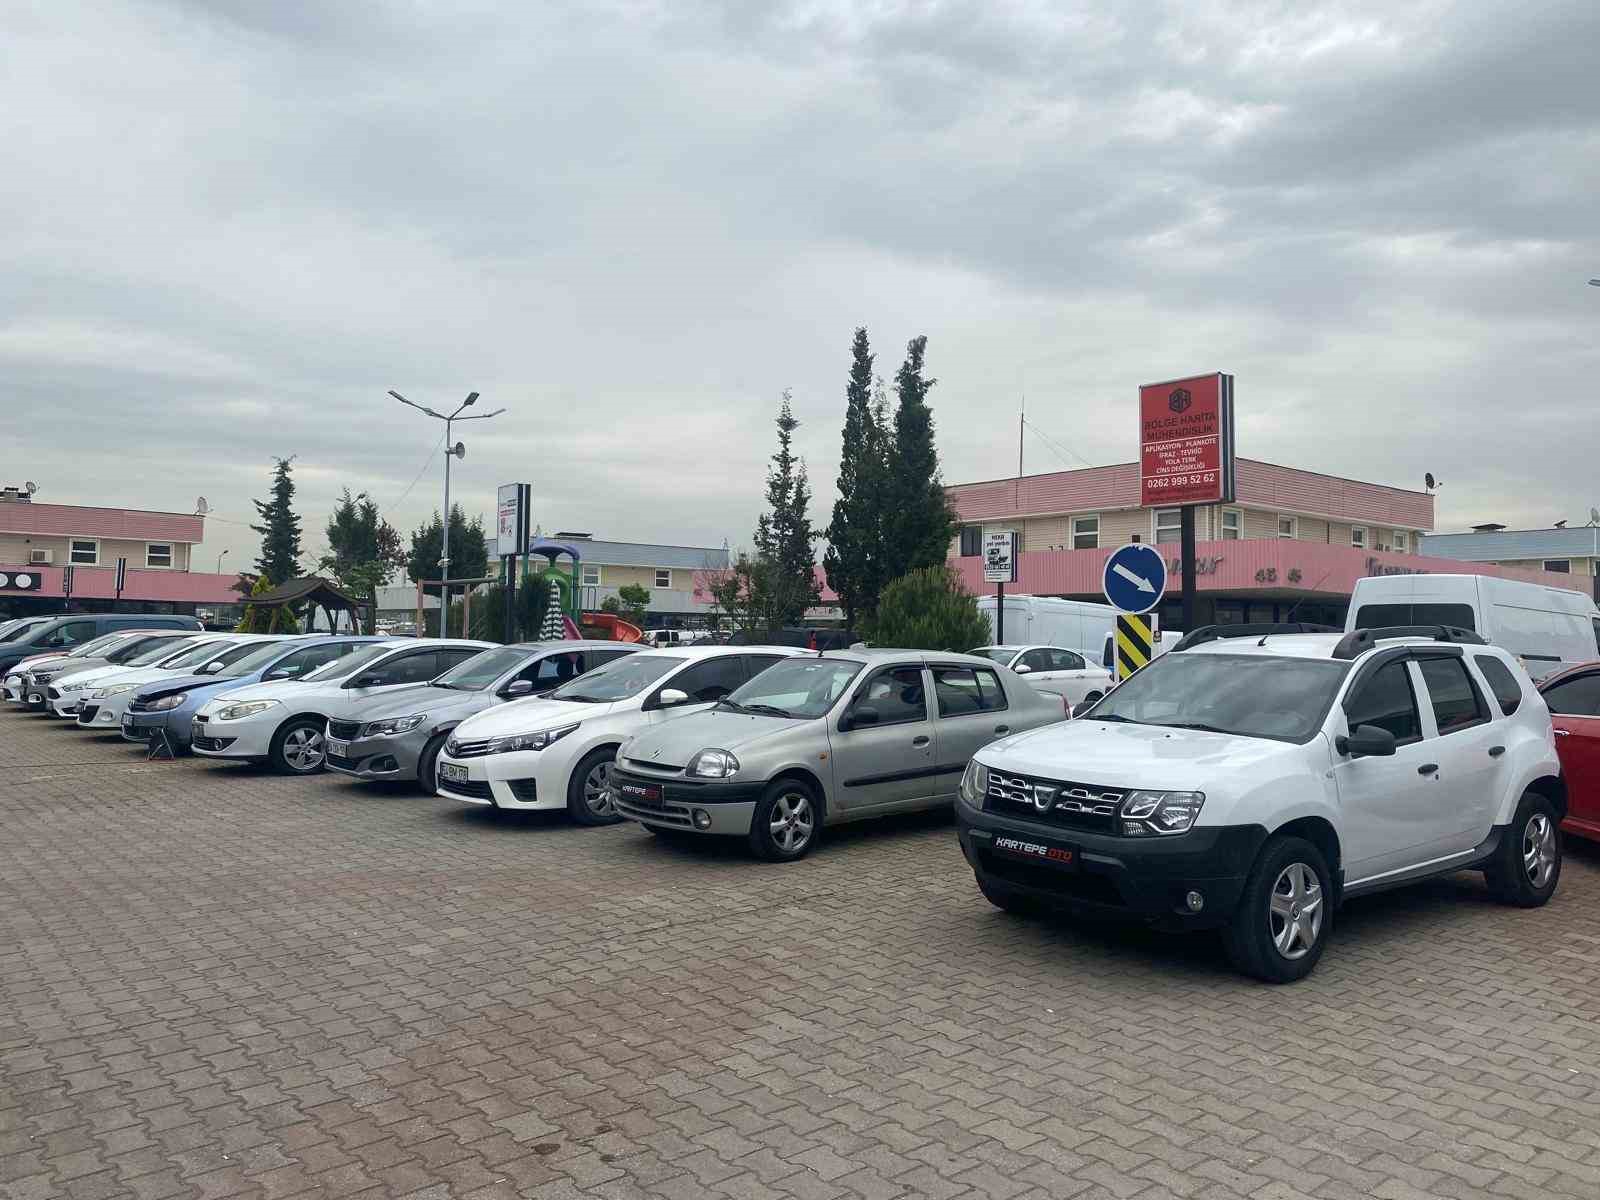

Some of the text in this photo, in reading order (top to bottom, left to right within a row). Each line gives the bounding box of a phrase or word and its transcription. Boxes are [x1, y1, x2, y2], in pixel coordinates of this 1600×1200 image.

[1147, 473, 1215, 489] 0262 999 52 62
[995, 837, 1073, 860] KARTEPE OTO
